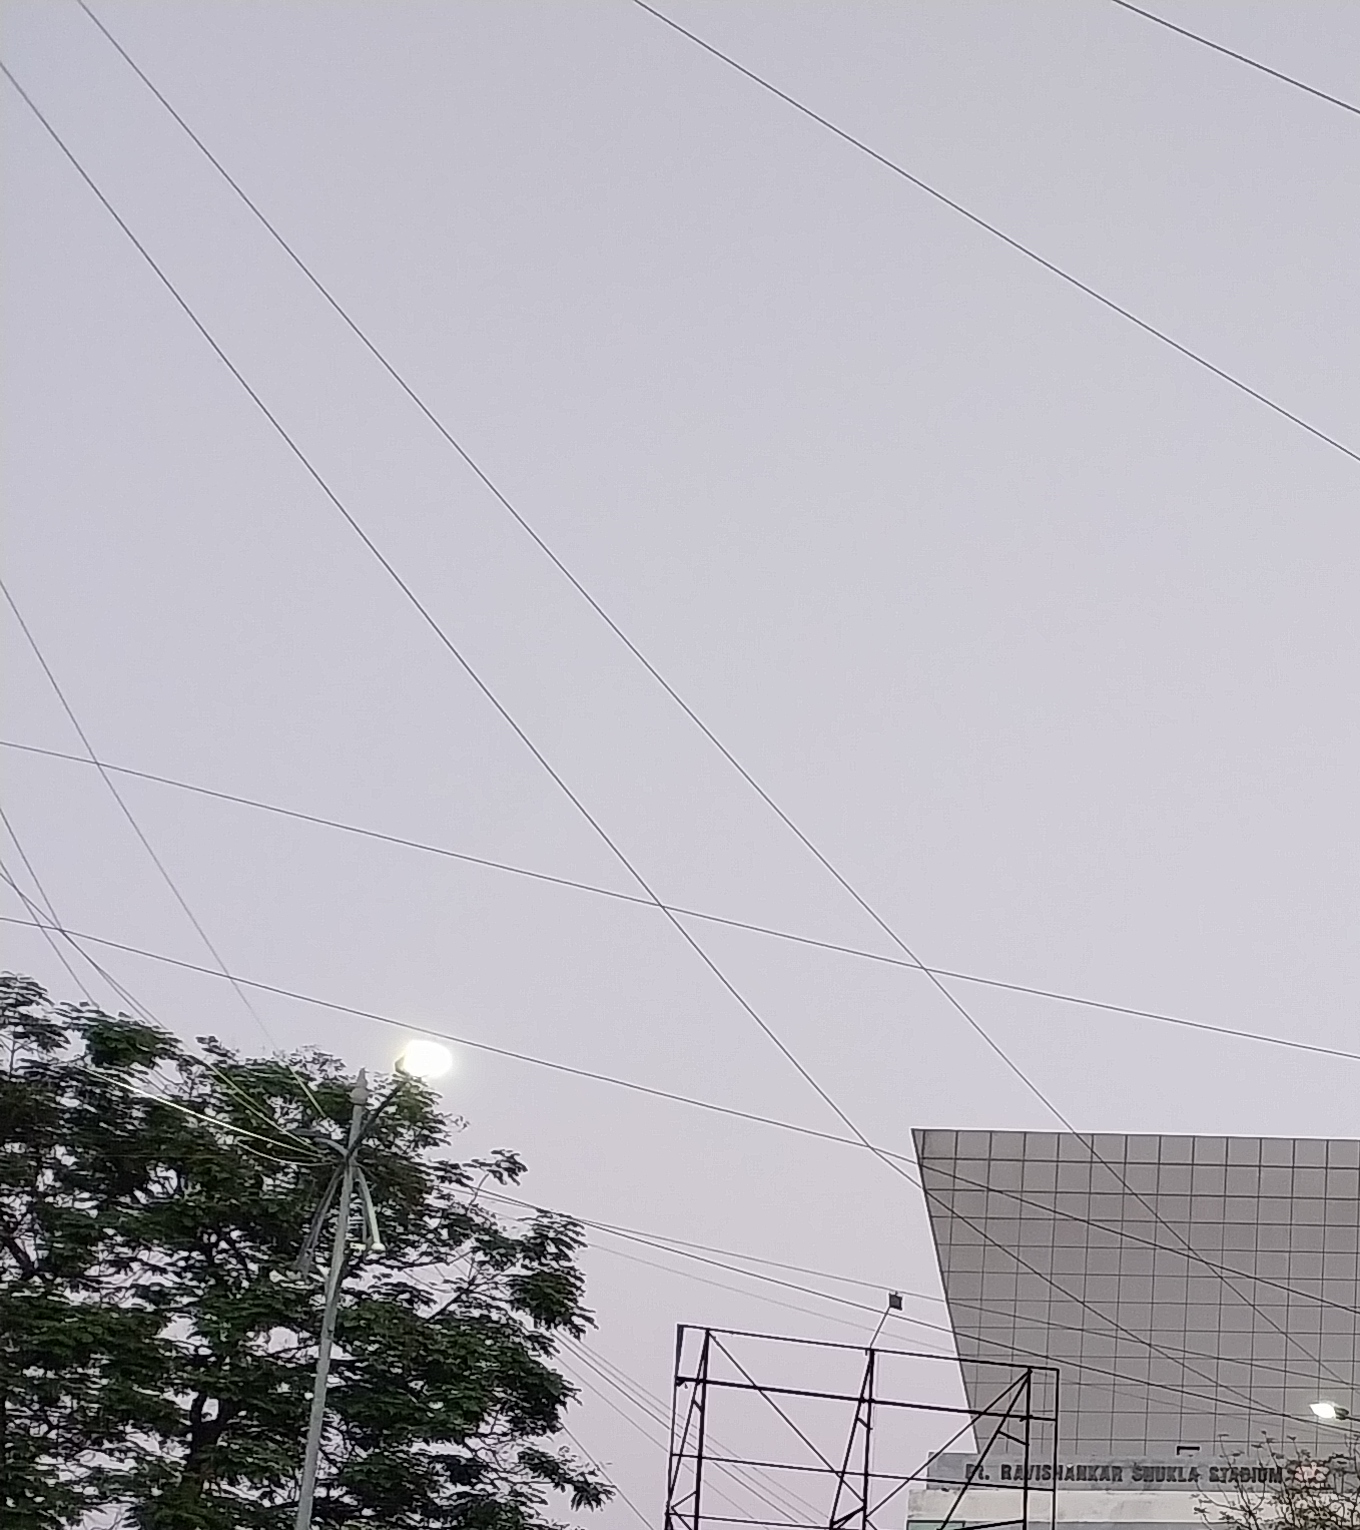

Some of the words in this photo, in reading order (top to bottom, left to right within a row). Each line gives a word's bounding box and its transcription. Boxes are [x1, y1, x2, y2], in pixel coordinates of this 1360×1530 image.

[1000, 1463, 1124, 1482] RAVISHANKAR
[1131, 1464, 1200, 1482] SHUKLA
[1208, 1465, 1283, 1484] STADIUM
